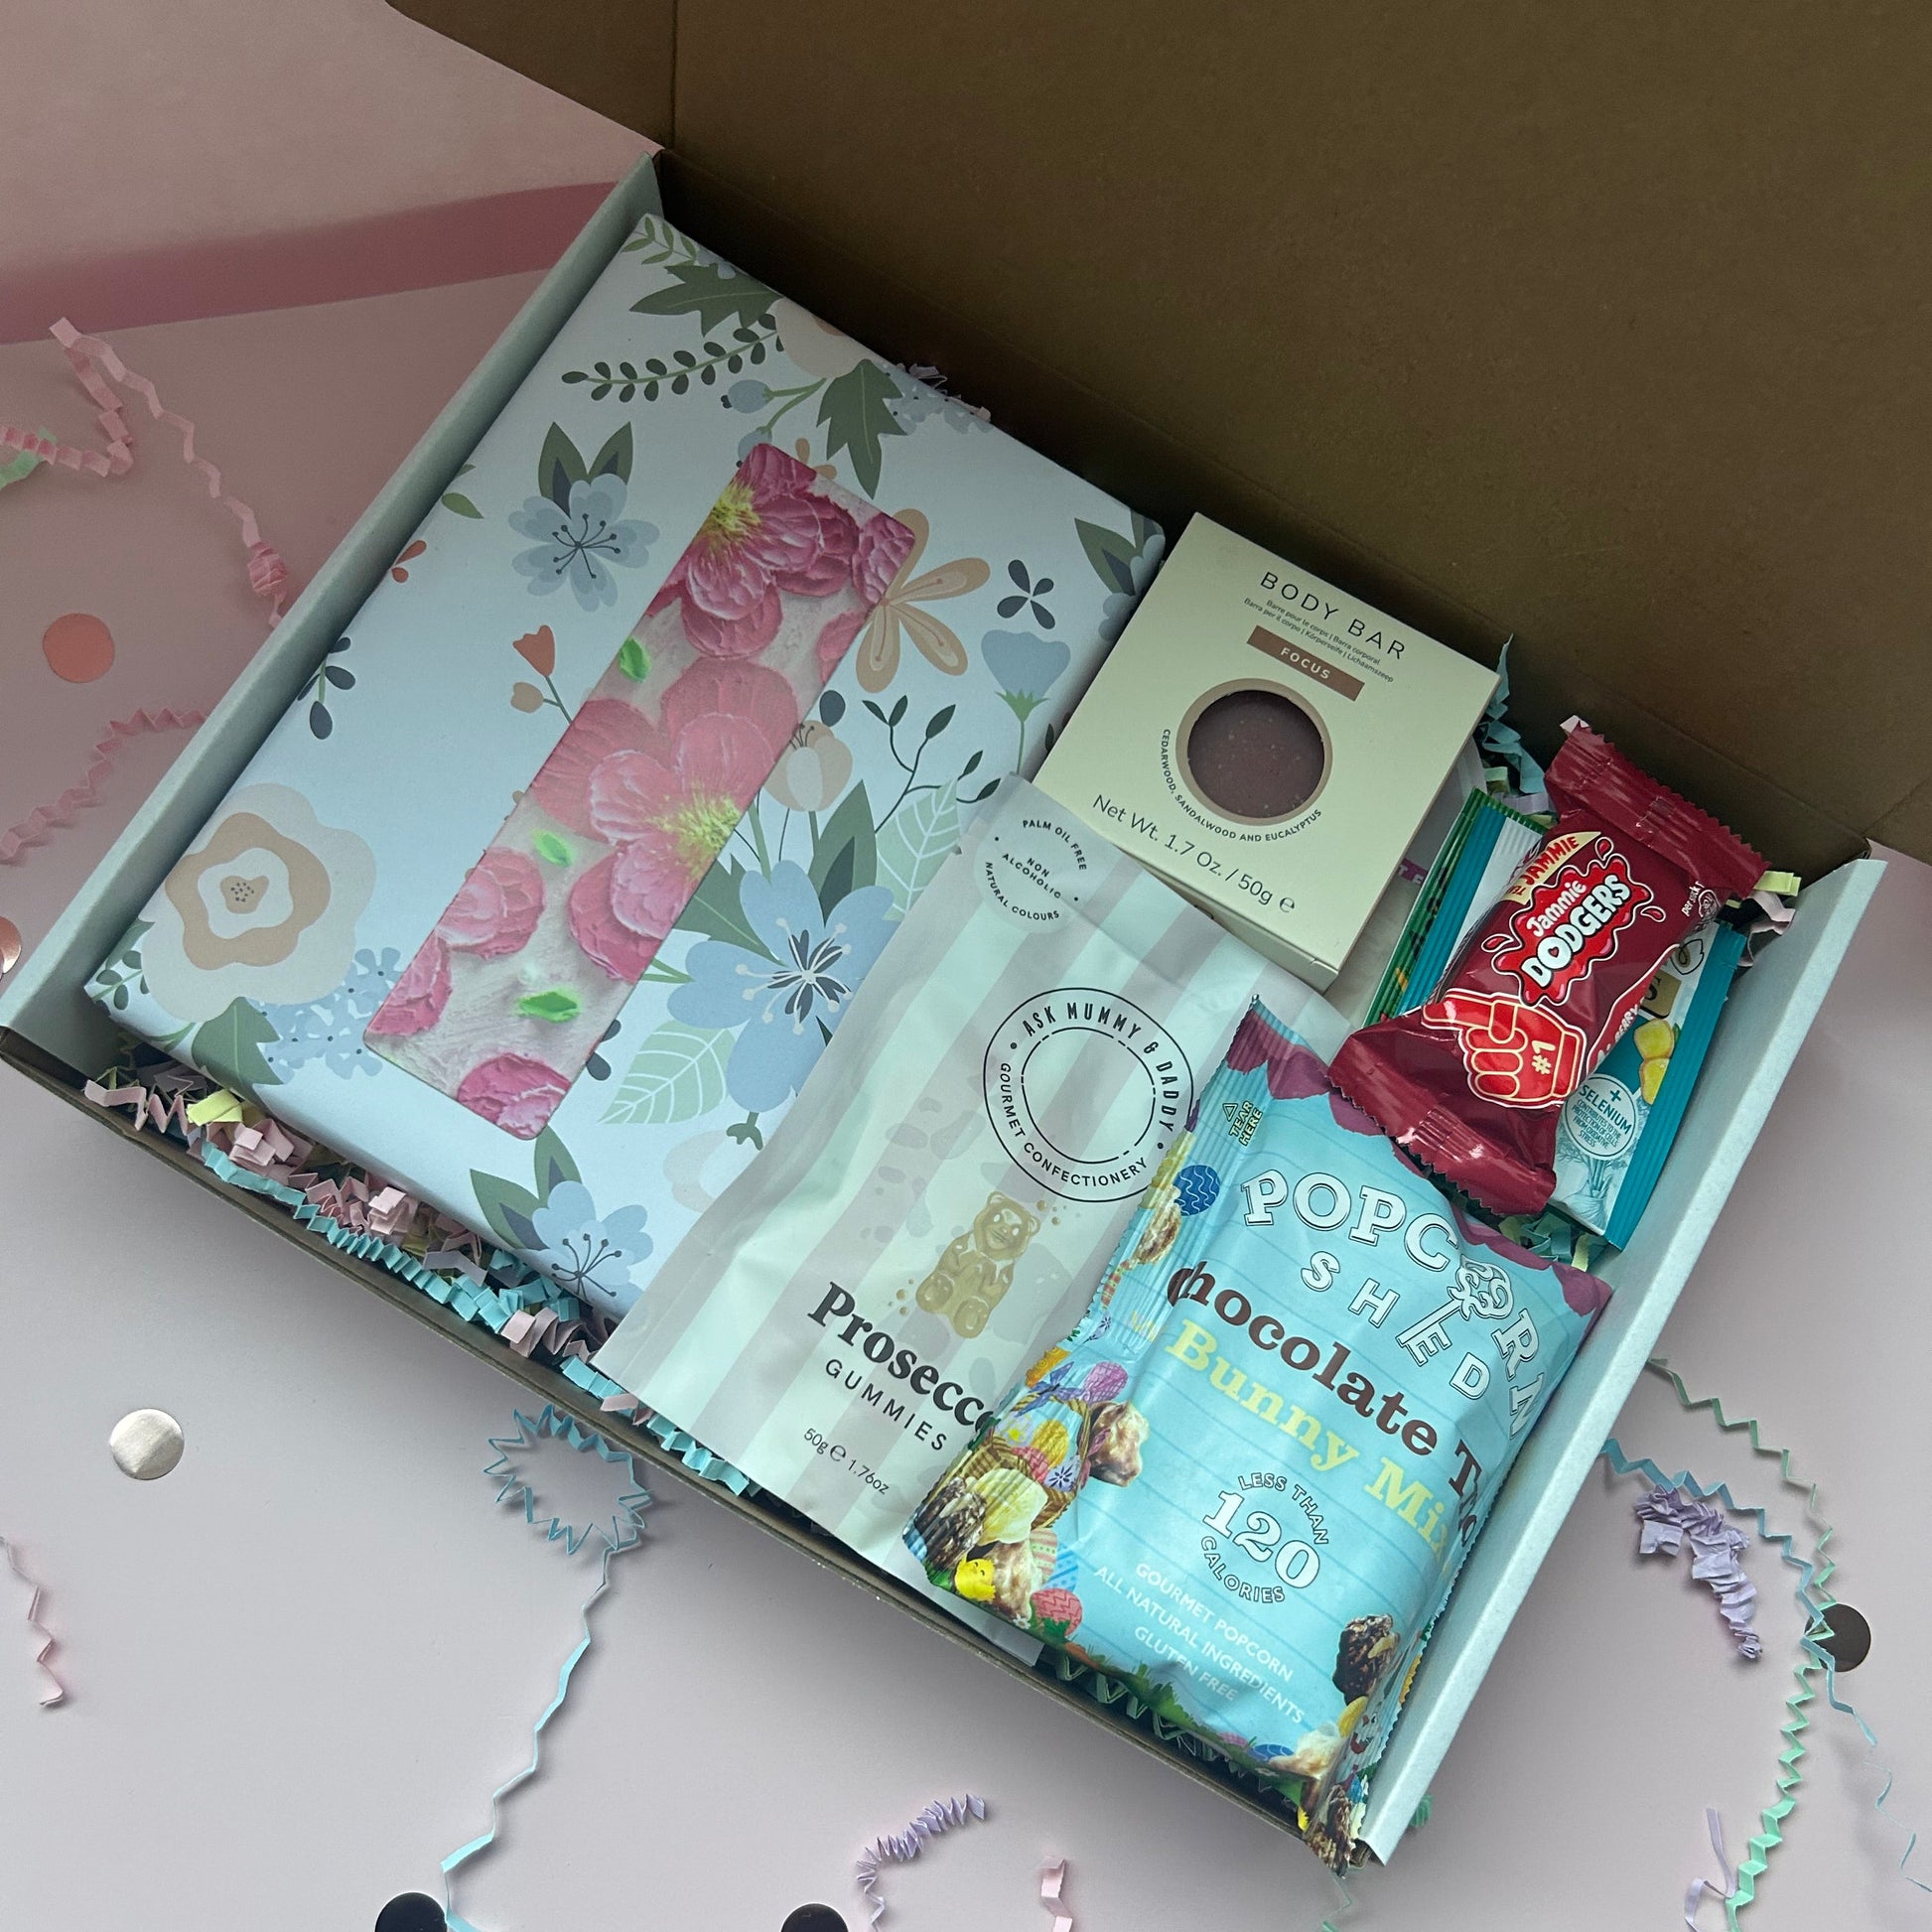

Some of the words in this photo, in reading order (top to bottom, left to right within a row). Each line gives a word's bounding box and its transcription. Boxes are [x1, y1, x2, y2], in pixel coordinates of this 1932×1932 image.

[1243, 598, 1263, 612] Barra
[1263, 606, 1277, 619] per
[1281, 618, 1301, 633] corpo
[1347, 653, 1394, 683] Lichaamszeep
[1260, 572, 1339, 621] BODY
[1348, 619, 1406, 660] BAR
[1266, 600, 1285, 614] Barre
[1285, 609, 1303, 623] pour
[1310, 622, 1328, 639] corps
[1333, 635, 1352, 651] Barra
[1351, 645, 1381, 665] corporal
[1280, 647, 1330, 679] FOCUS
[1161, 729, 1176, 794] CEDARWOOD,
[1174, 794, 1236, 839] SANDALWOOD
[1239, 833, 1262, 842] AND
[1265, 809, 1322, 842] EUCALYPTUS
[1002, 853, 1061, 898] ALCOHOLIC
[1023, 820, 1051, 830] PALM
[1054, 827, 1070, 843] OIL
[1070, 843, 1087, 871] FREE
[1027, 858, 1049, 878] NON
[1092, 794, 1126, 822] Net
[1130, 812, 1159, 841] Wt.
[1165, 834, 1195, 856] 1.7
[1196, 851, 1222, 876] Oz.
[1238, 874, 1273, 905] 50g
[1520, 837, 1580, 886] JAMMIE
[985, 861, 1009, 907] NATURAL
[1012, 905, 1059, 920] COLOURS
[1526, 881, 1587, 937] Jammie
[1520, 874, 1630, 988] DODGERS
[1023, 1006, 1056, 1036] ASK
[1067, 1003, 1142, 1039] MUMMY
[1144, 1041, 1159, 1054] &
[1156, 1060, 1179, 1132] DADDY
[1531, 1039, 1557, 1075] #1
[1000, 1062, 1026, 1138] GOURMET
[1024, 1142, 1148, 1186] CONFECTIONERY
[1228, 1100, 1253, 1138] TEAR
[1239, 1108, 1264, 1147] HERE
[1571, 1104, 1600, 1130] PROTECTION
[1597, 1126, 1606, 1135] OF
[1604, 1132, 1618, 1147] CELLS
[1573, 1115, 1587, 1129] FROM
[1586, 1126, 1609, 1149] OXIDATIVE
[1576, 1098, 1607, 1127] CONTRIBUTES
[1605, 1123, 1614, 1132] TO
[1611, 1128, 1621, 1140] THE
[1578, 1130, 1596, 1147] STRESS
[1579, 1084, 1632, 1135] SELENIUM
[1301, 1251, 1490, 1400] SHED
[825, 1358, 947, 1450] GUMMIES
[1165, 1319, 1359, 1471] Bunny
[804, 1428, 828, 1455] 50g
[848, 1458, 890, 1494] 1.76oz
[1202, 1490, 1320, 1589] 120
[1238, 1471, 1288, 1491] LESS
[1291, 1485, 1329, 1546] THAN
[1200, 1535, 1286, 1603] CALORIES
[1094, 1566, 1125, 1593] ALL
[1126, 1587, 1197, 1649] NATURAL
[1202, 1640, 1306, 1725] INGREDIENTS
[1135, 1563, 1214, 1624] GOURMET
[1213, 1618, 1294, 1683] POPCORN
[1134, 1625, 1197, 1678] GLUTEN
[1199, 1672, 1239, 1703] FREE
